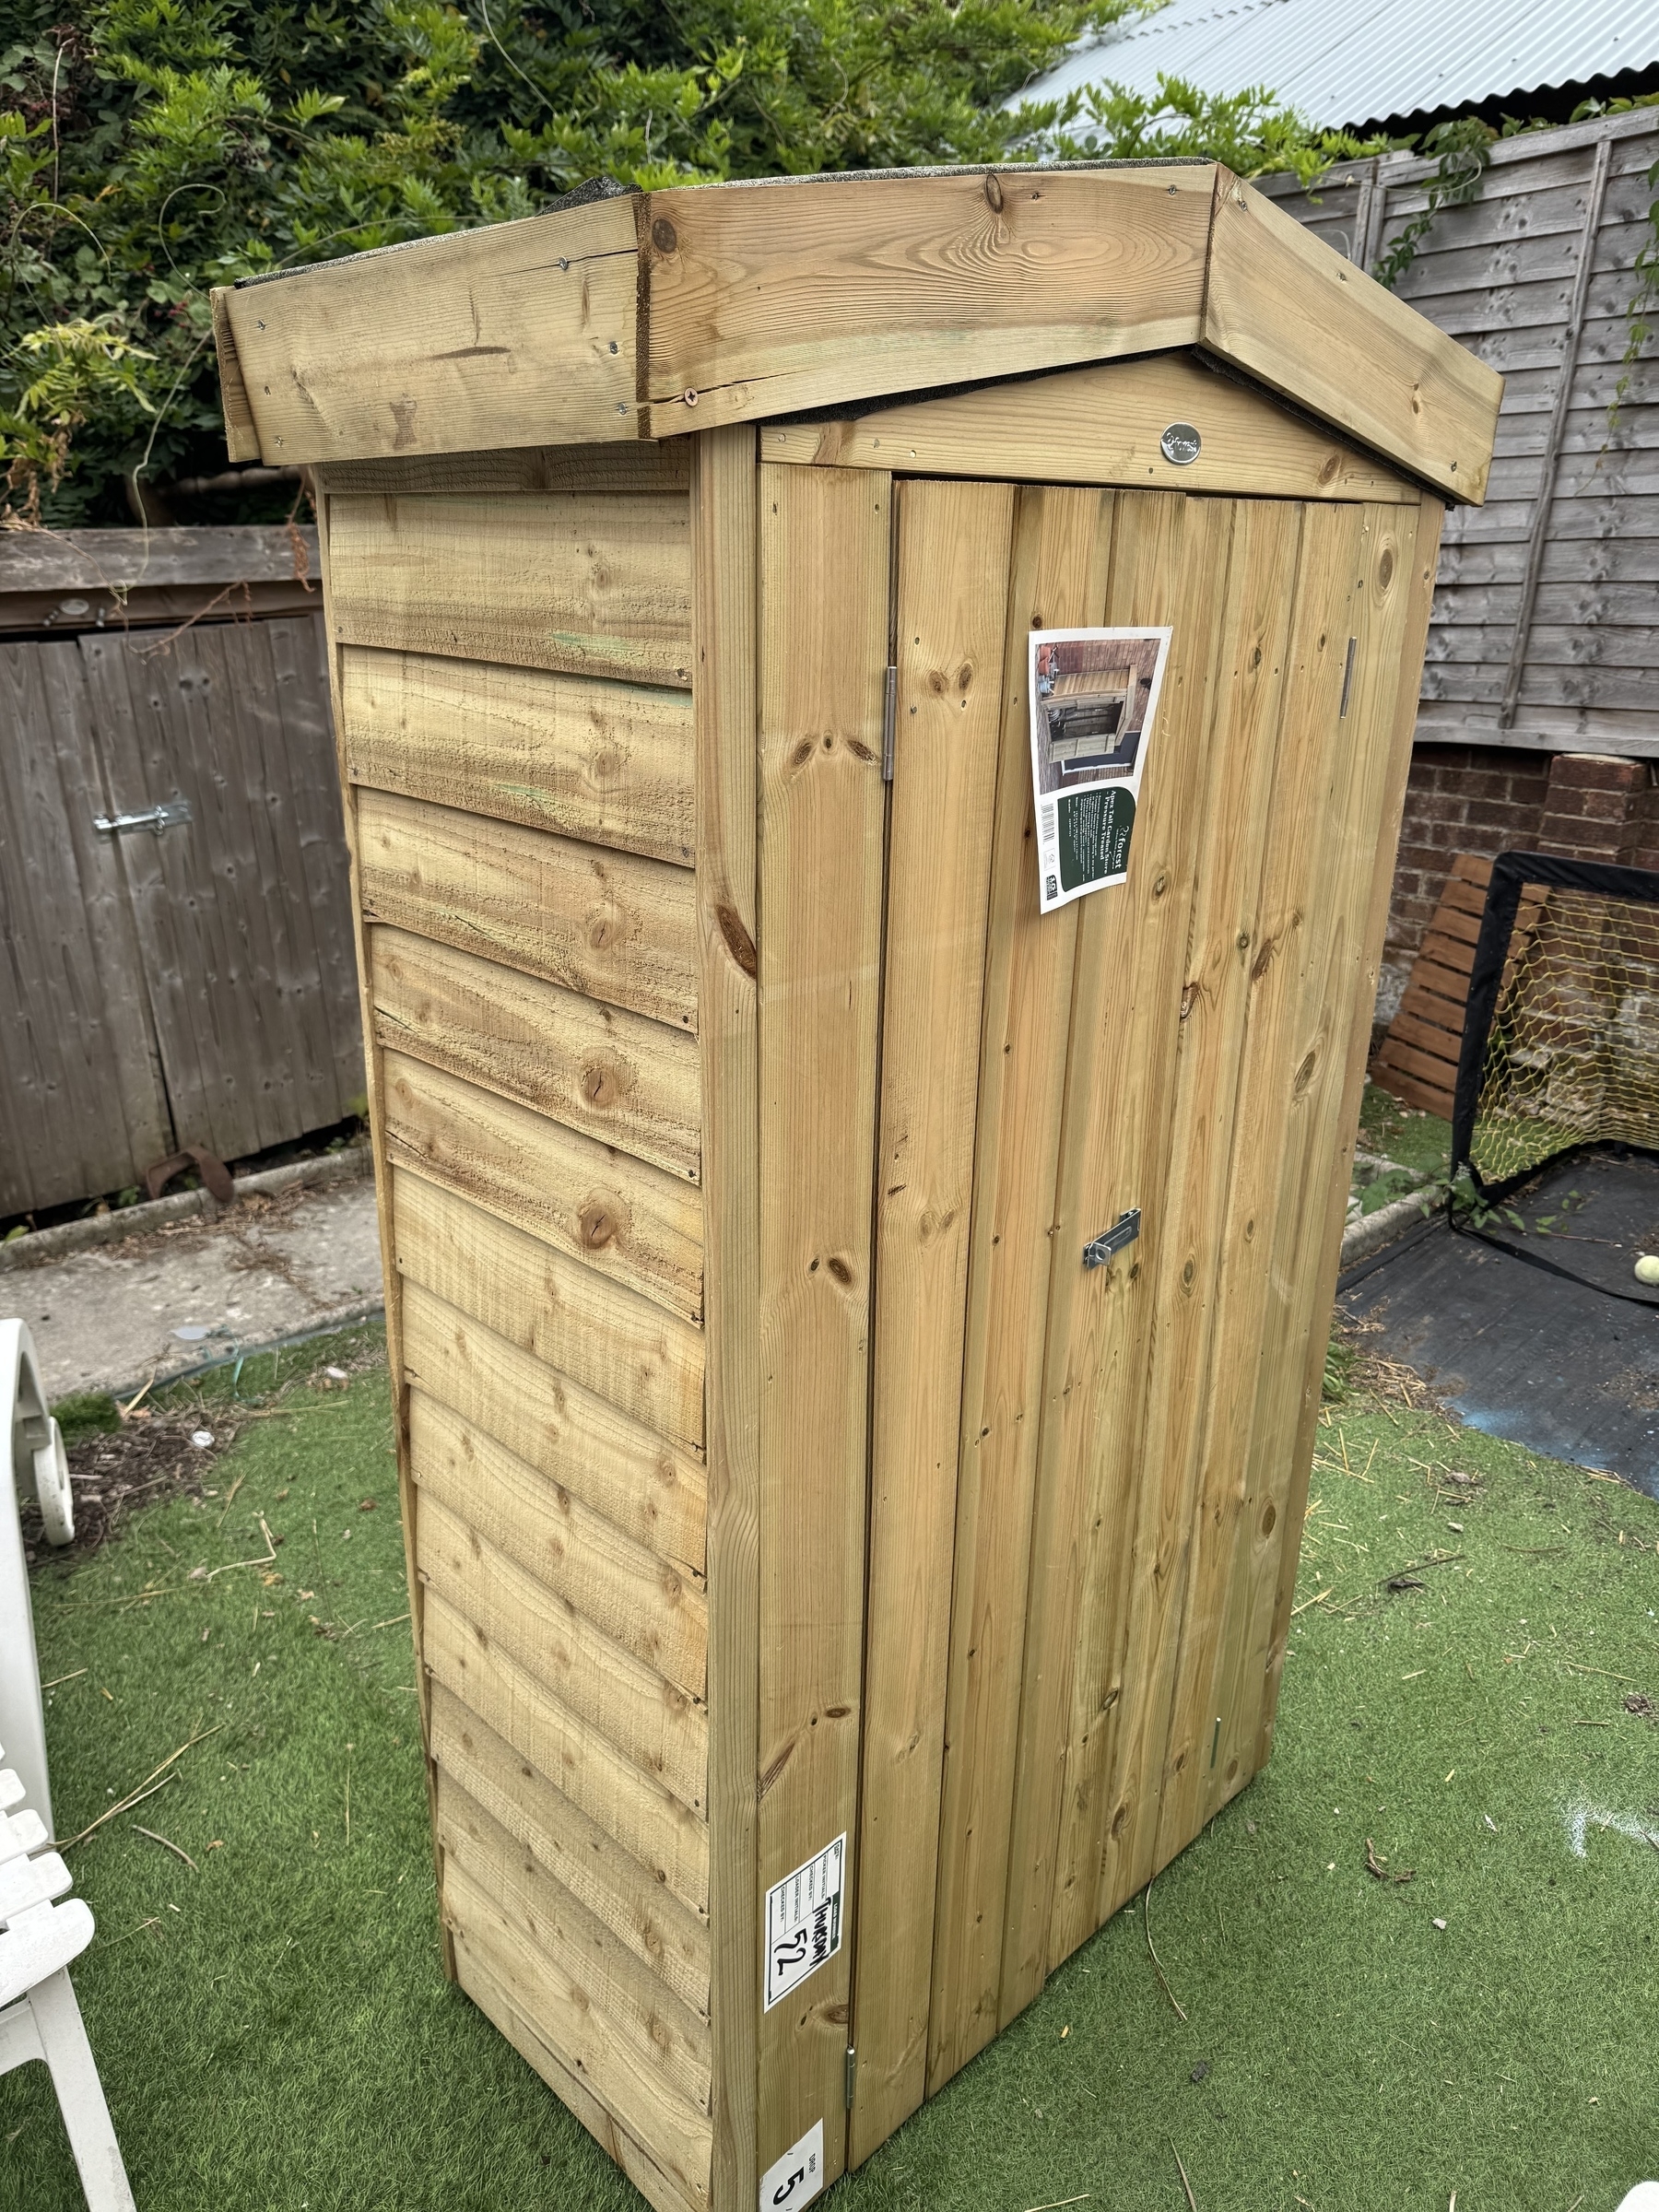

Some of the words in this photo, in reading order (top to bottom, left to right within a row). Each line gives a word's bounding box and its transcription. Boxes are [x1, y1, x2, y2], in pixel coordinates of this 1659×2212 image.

[1101, 796, 1110, 830] Pressure
[1115, 838, 1126, 869] forest
[809, 1897, 831, 1966] THURSDAY
[774, 1928, 807, 1976] 52
[772, 2166, 805, 2206] 5
